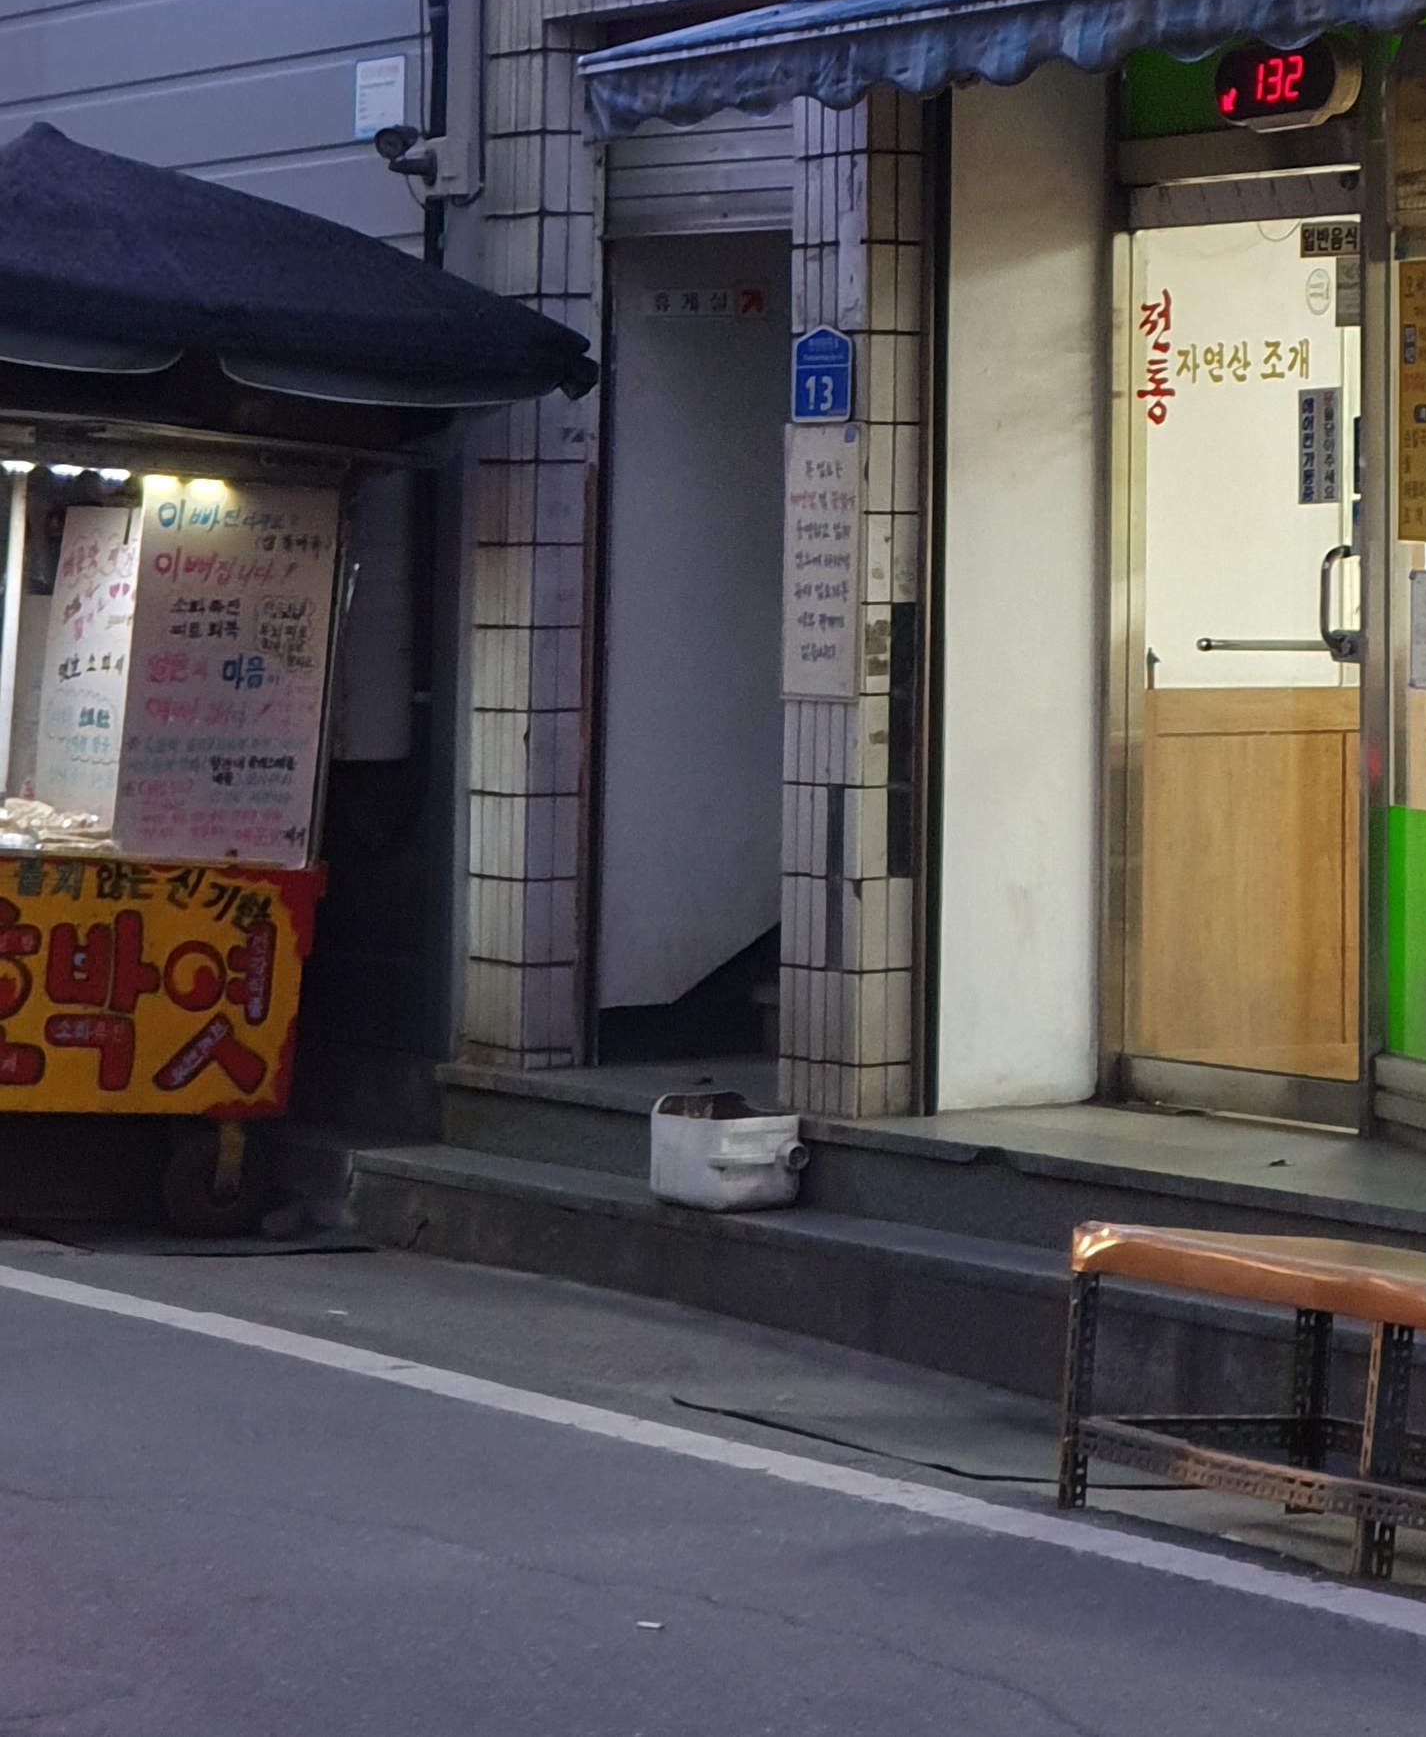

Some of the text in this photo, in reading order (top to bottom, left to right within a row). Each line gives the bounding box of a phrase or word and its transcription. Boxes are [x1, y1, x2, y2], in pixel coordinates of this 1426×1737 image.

[1255, 55, 1303, 102] 132
[1138, 288, 1176, 425] 전통
[1175, 339, 1310, 384] 자연산 조개
[804, 375, 834, 412] 13
